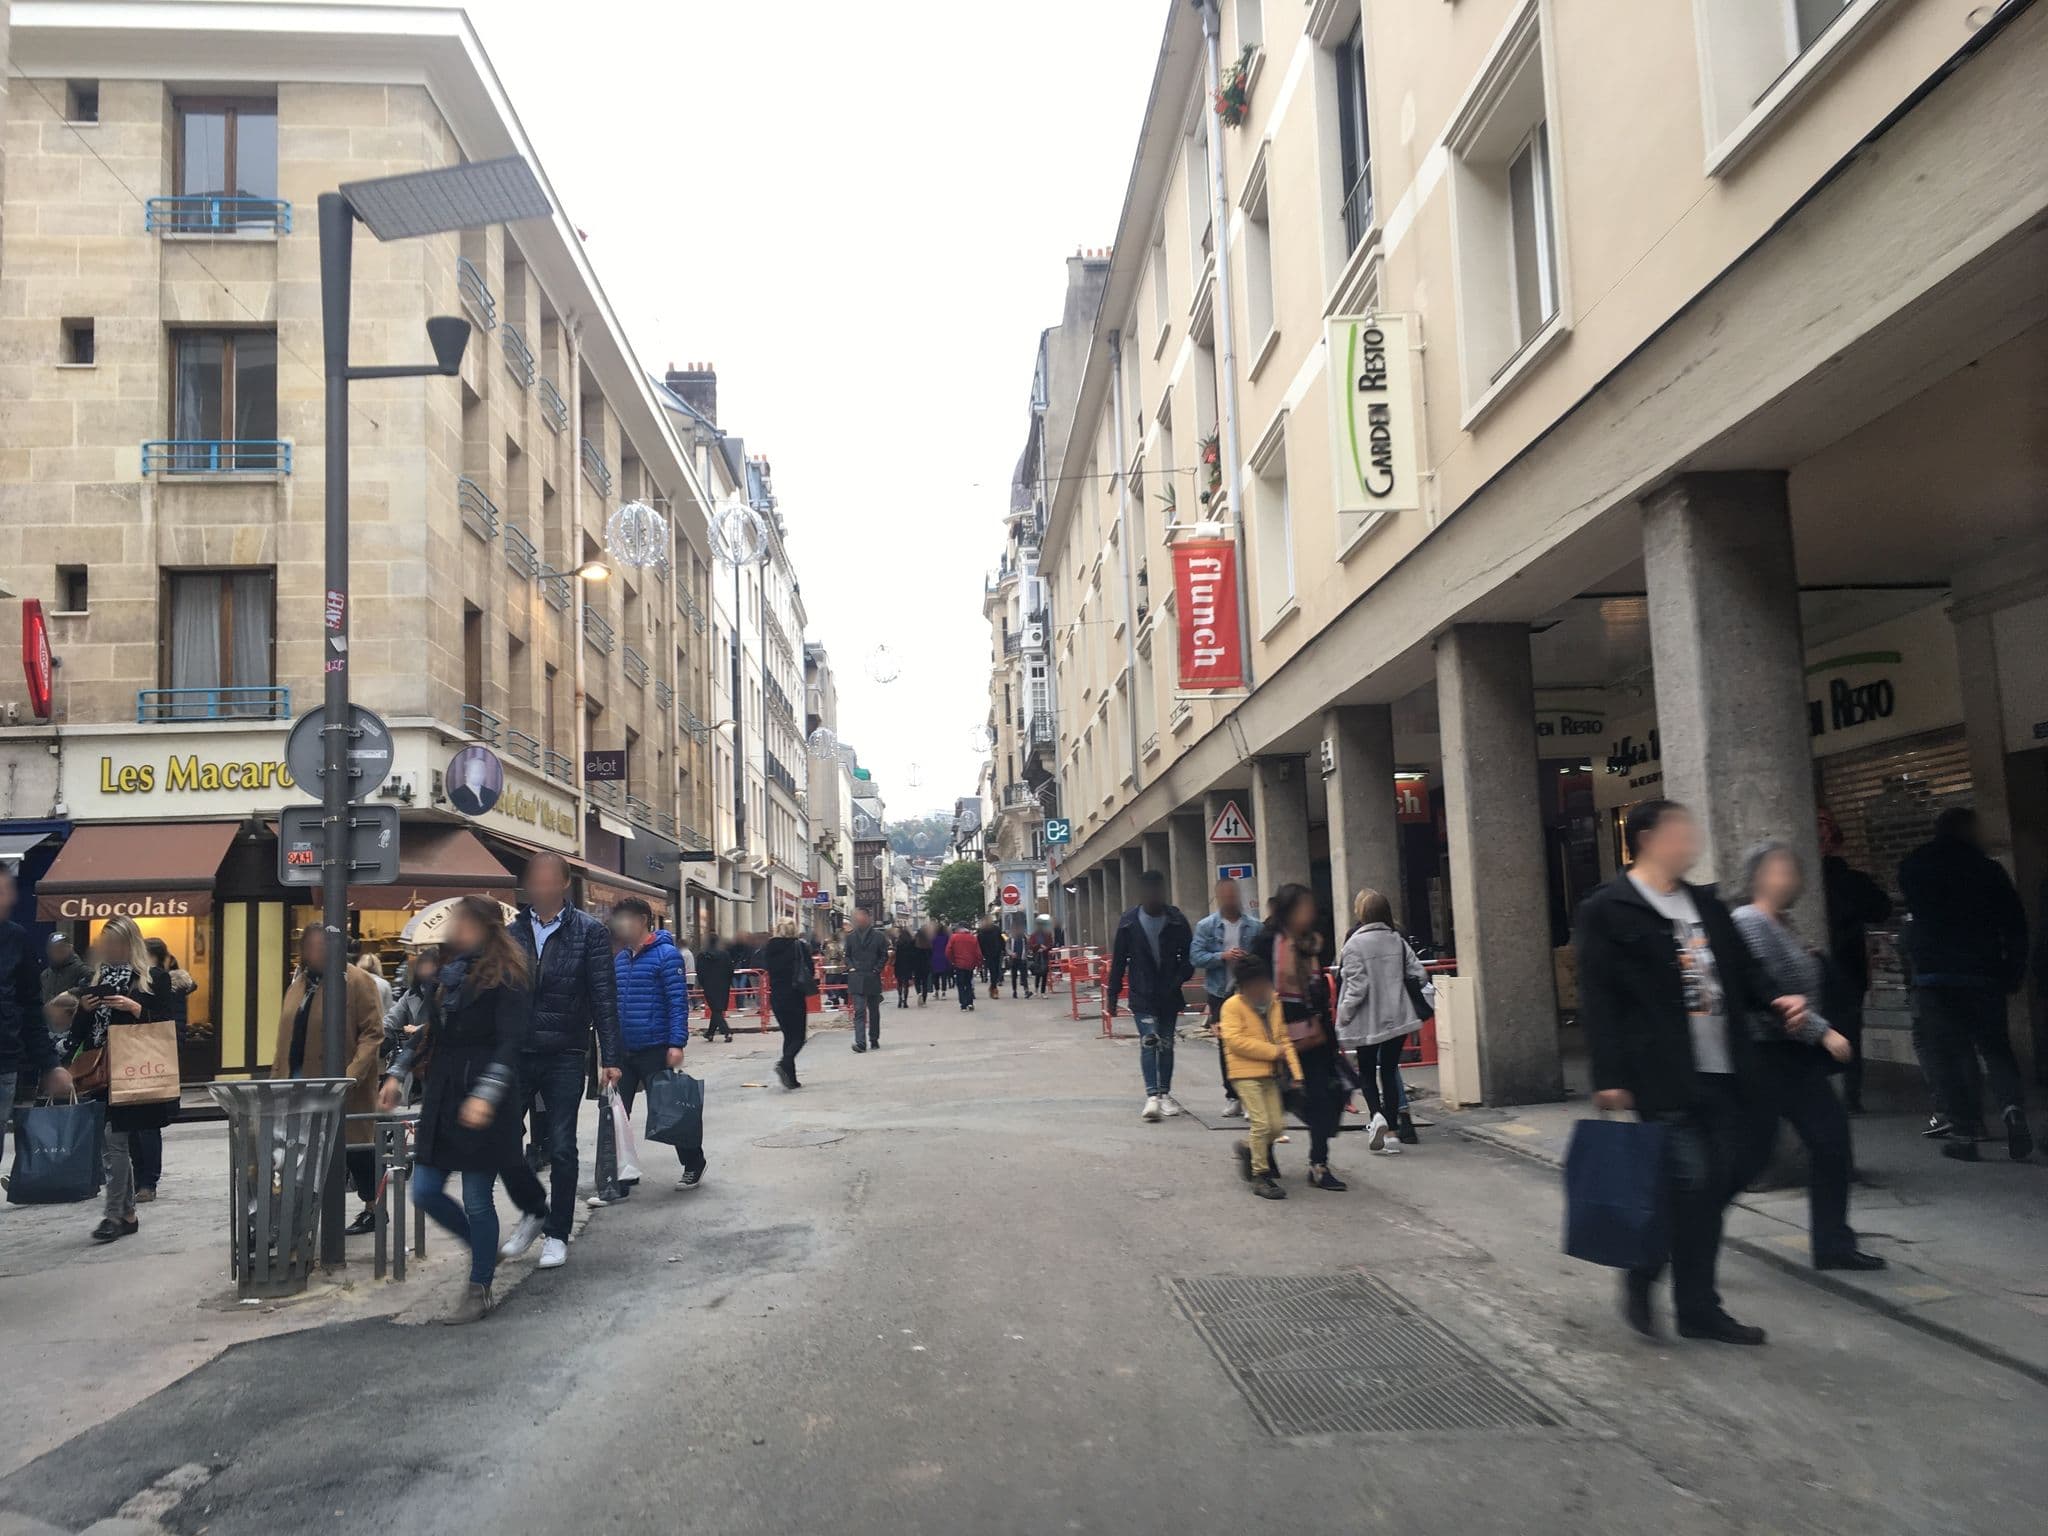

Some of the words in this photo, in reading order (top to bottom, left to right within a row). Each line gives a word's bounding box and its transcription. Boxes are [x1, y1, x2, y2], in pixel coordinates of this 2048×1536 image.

[1358, 328, 1387, 392] RESTO
[1189, 557, 1225, 667] flunch
[100, 756, 154, 793] Les
[587, 757, 617, 773] eliot
[60, 896, 189, 918] Chocolats
[423, 912, 443, 930] les
[125, 1061, 165, 1077] edc
